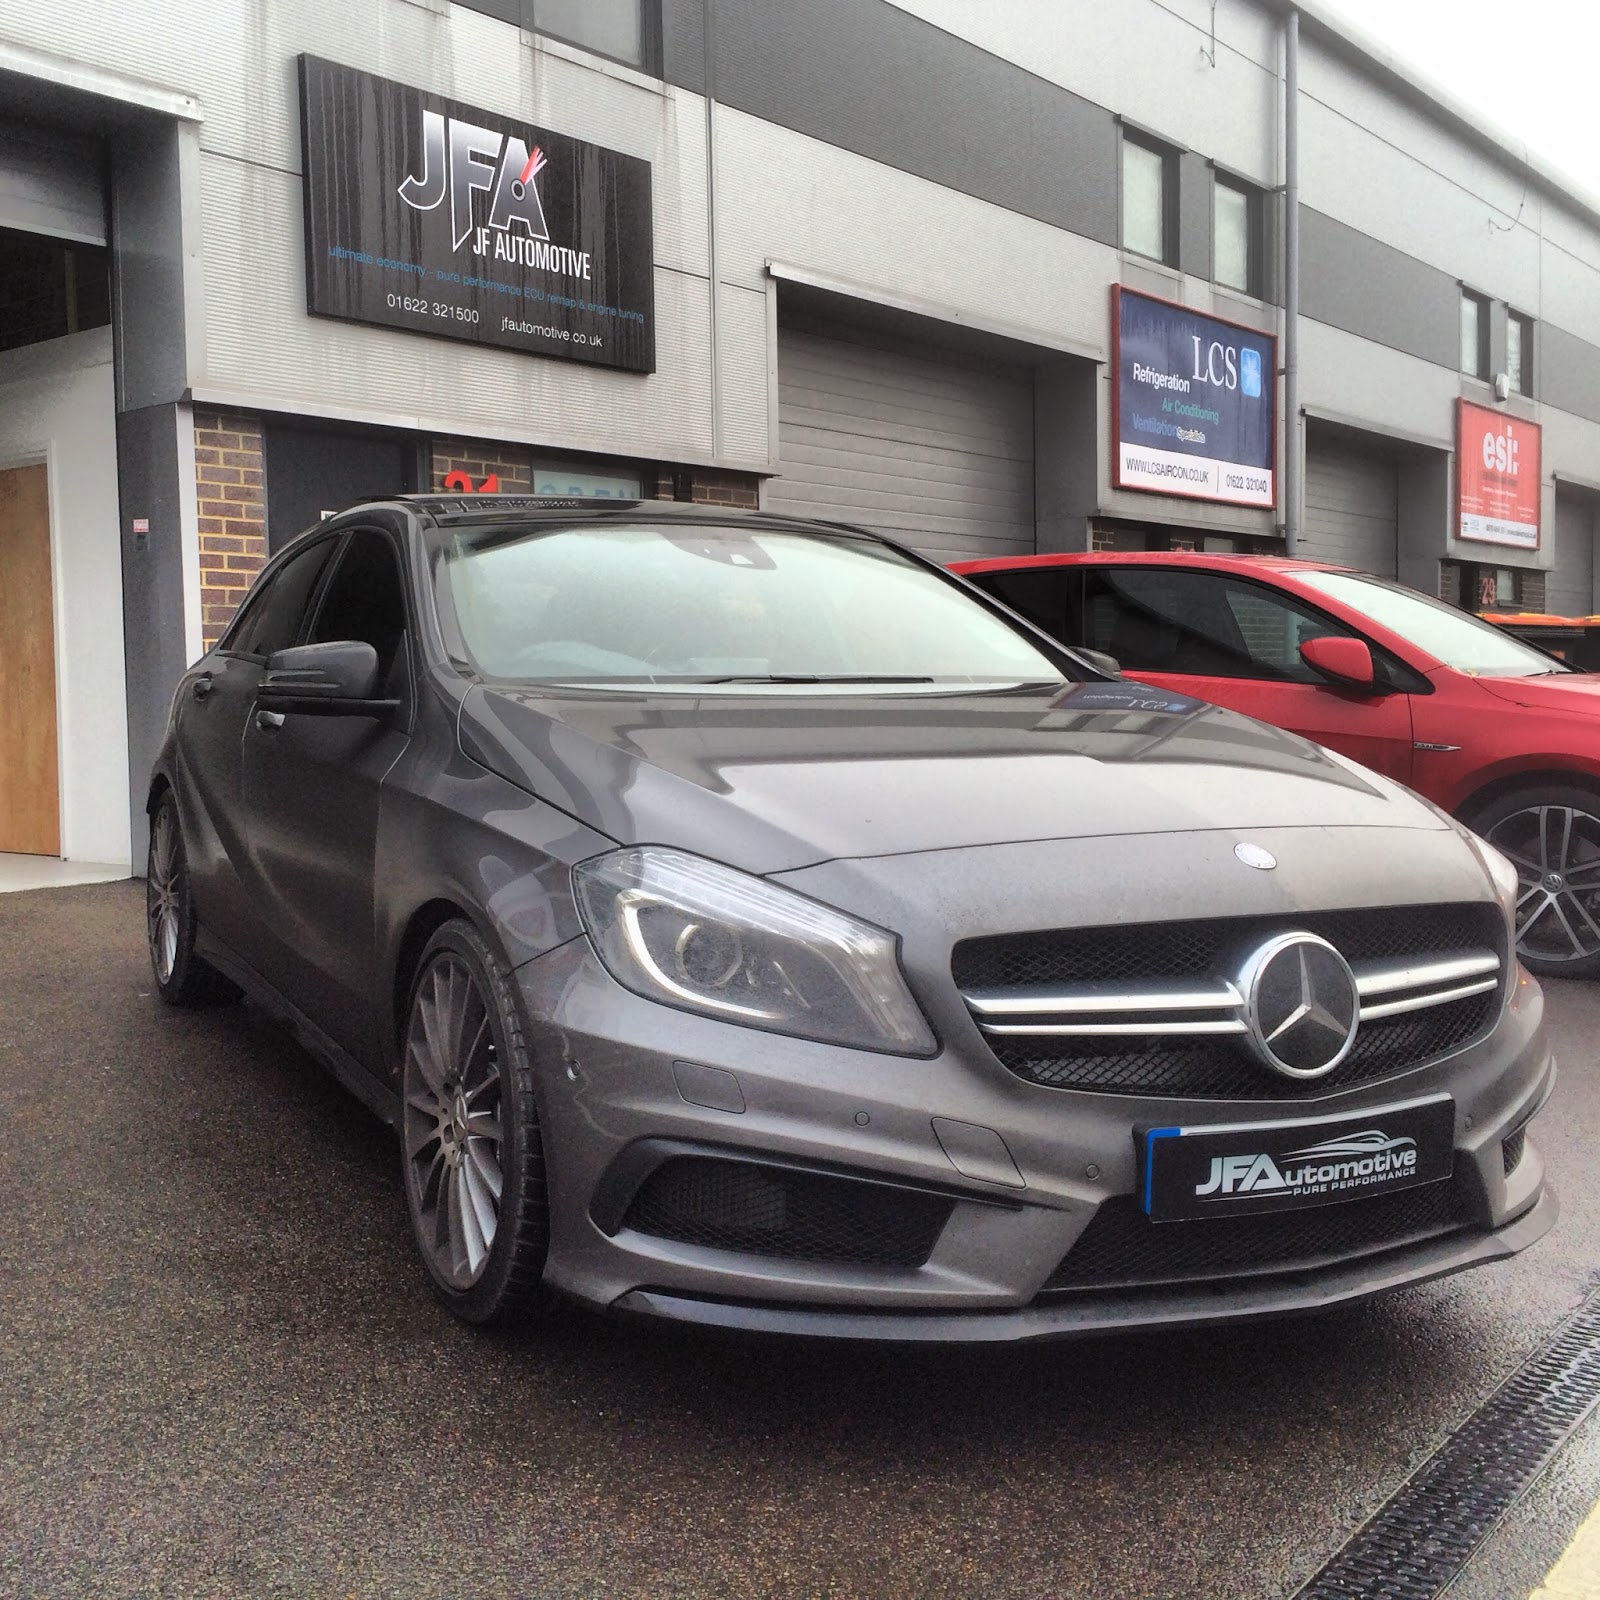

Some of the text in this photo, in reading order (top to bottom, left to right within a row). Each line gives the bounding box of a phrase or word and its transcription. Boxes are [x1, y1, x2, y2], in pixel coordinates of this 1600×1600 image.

[397, 109, 550, 253] JFA
[473, 227, 591, 281] JF AUTOMOTIVE
[327, 245, 374, 265] ultimate
[376, 256, 427, 278] economy
[437, 270, 460, 283] pure
[463, 275, 521, 297] performance
[524, 286, 545, 301] ECU
[547, 293, 577, 310] remap
[578, 300, 586, 310] &
[587, 302, 617, 316] engine
[618, 308, 644, 324] tuning
[387, 293, 479, 324] 01622 321500
[501, 316, 603, 347] jfautomotive.co.uk
[1133, 362, 1190, 393] Refrigeration
[1192, 335, 1238, 390] LCS
[1132, 412, 1177, 438] Ventilation
[1162, 397, 1219, 425] Air Conditioning
[1126, 457, 1209, 483] WWW.LCSAIRCON.CO.UK
[1226, 473, 1244, 489] 01622
[1481, 577, 1496, 604] 29
[1195, 1149, 1417, 1196] JFAutomotive
[1293, 1166, 1417, 1196] PURE PERFORMANCE
